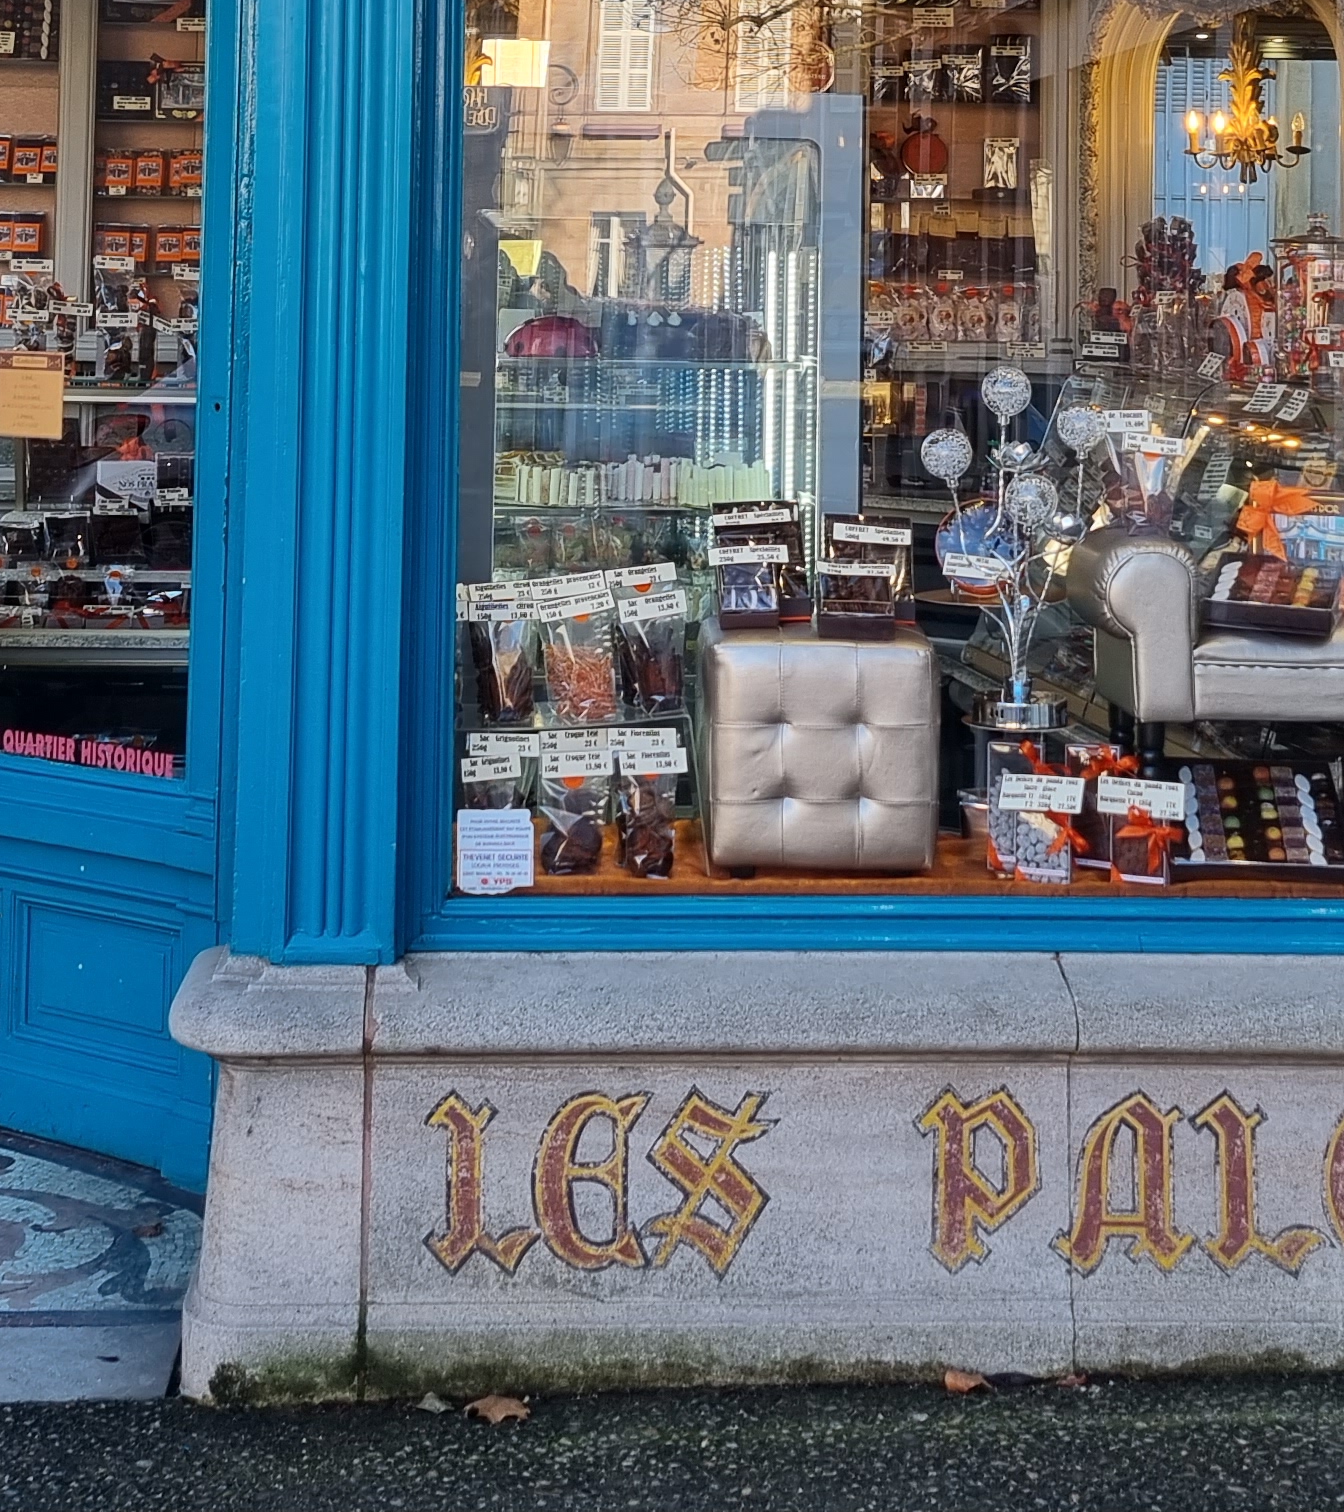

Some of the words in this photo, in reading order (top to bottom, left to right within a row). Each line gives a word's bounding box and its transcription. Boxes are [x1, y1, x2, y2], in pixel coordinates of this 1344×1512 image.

[3, 729, 76, 763] QUARTIER
[80, 739, 175, 779] HISTORIQUE
[424, 1084, 780, 1281] LES
